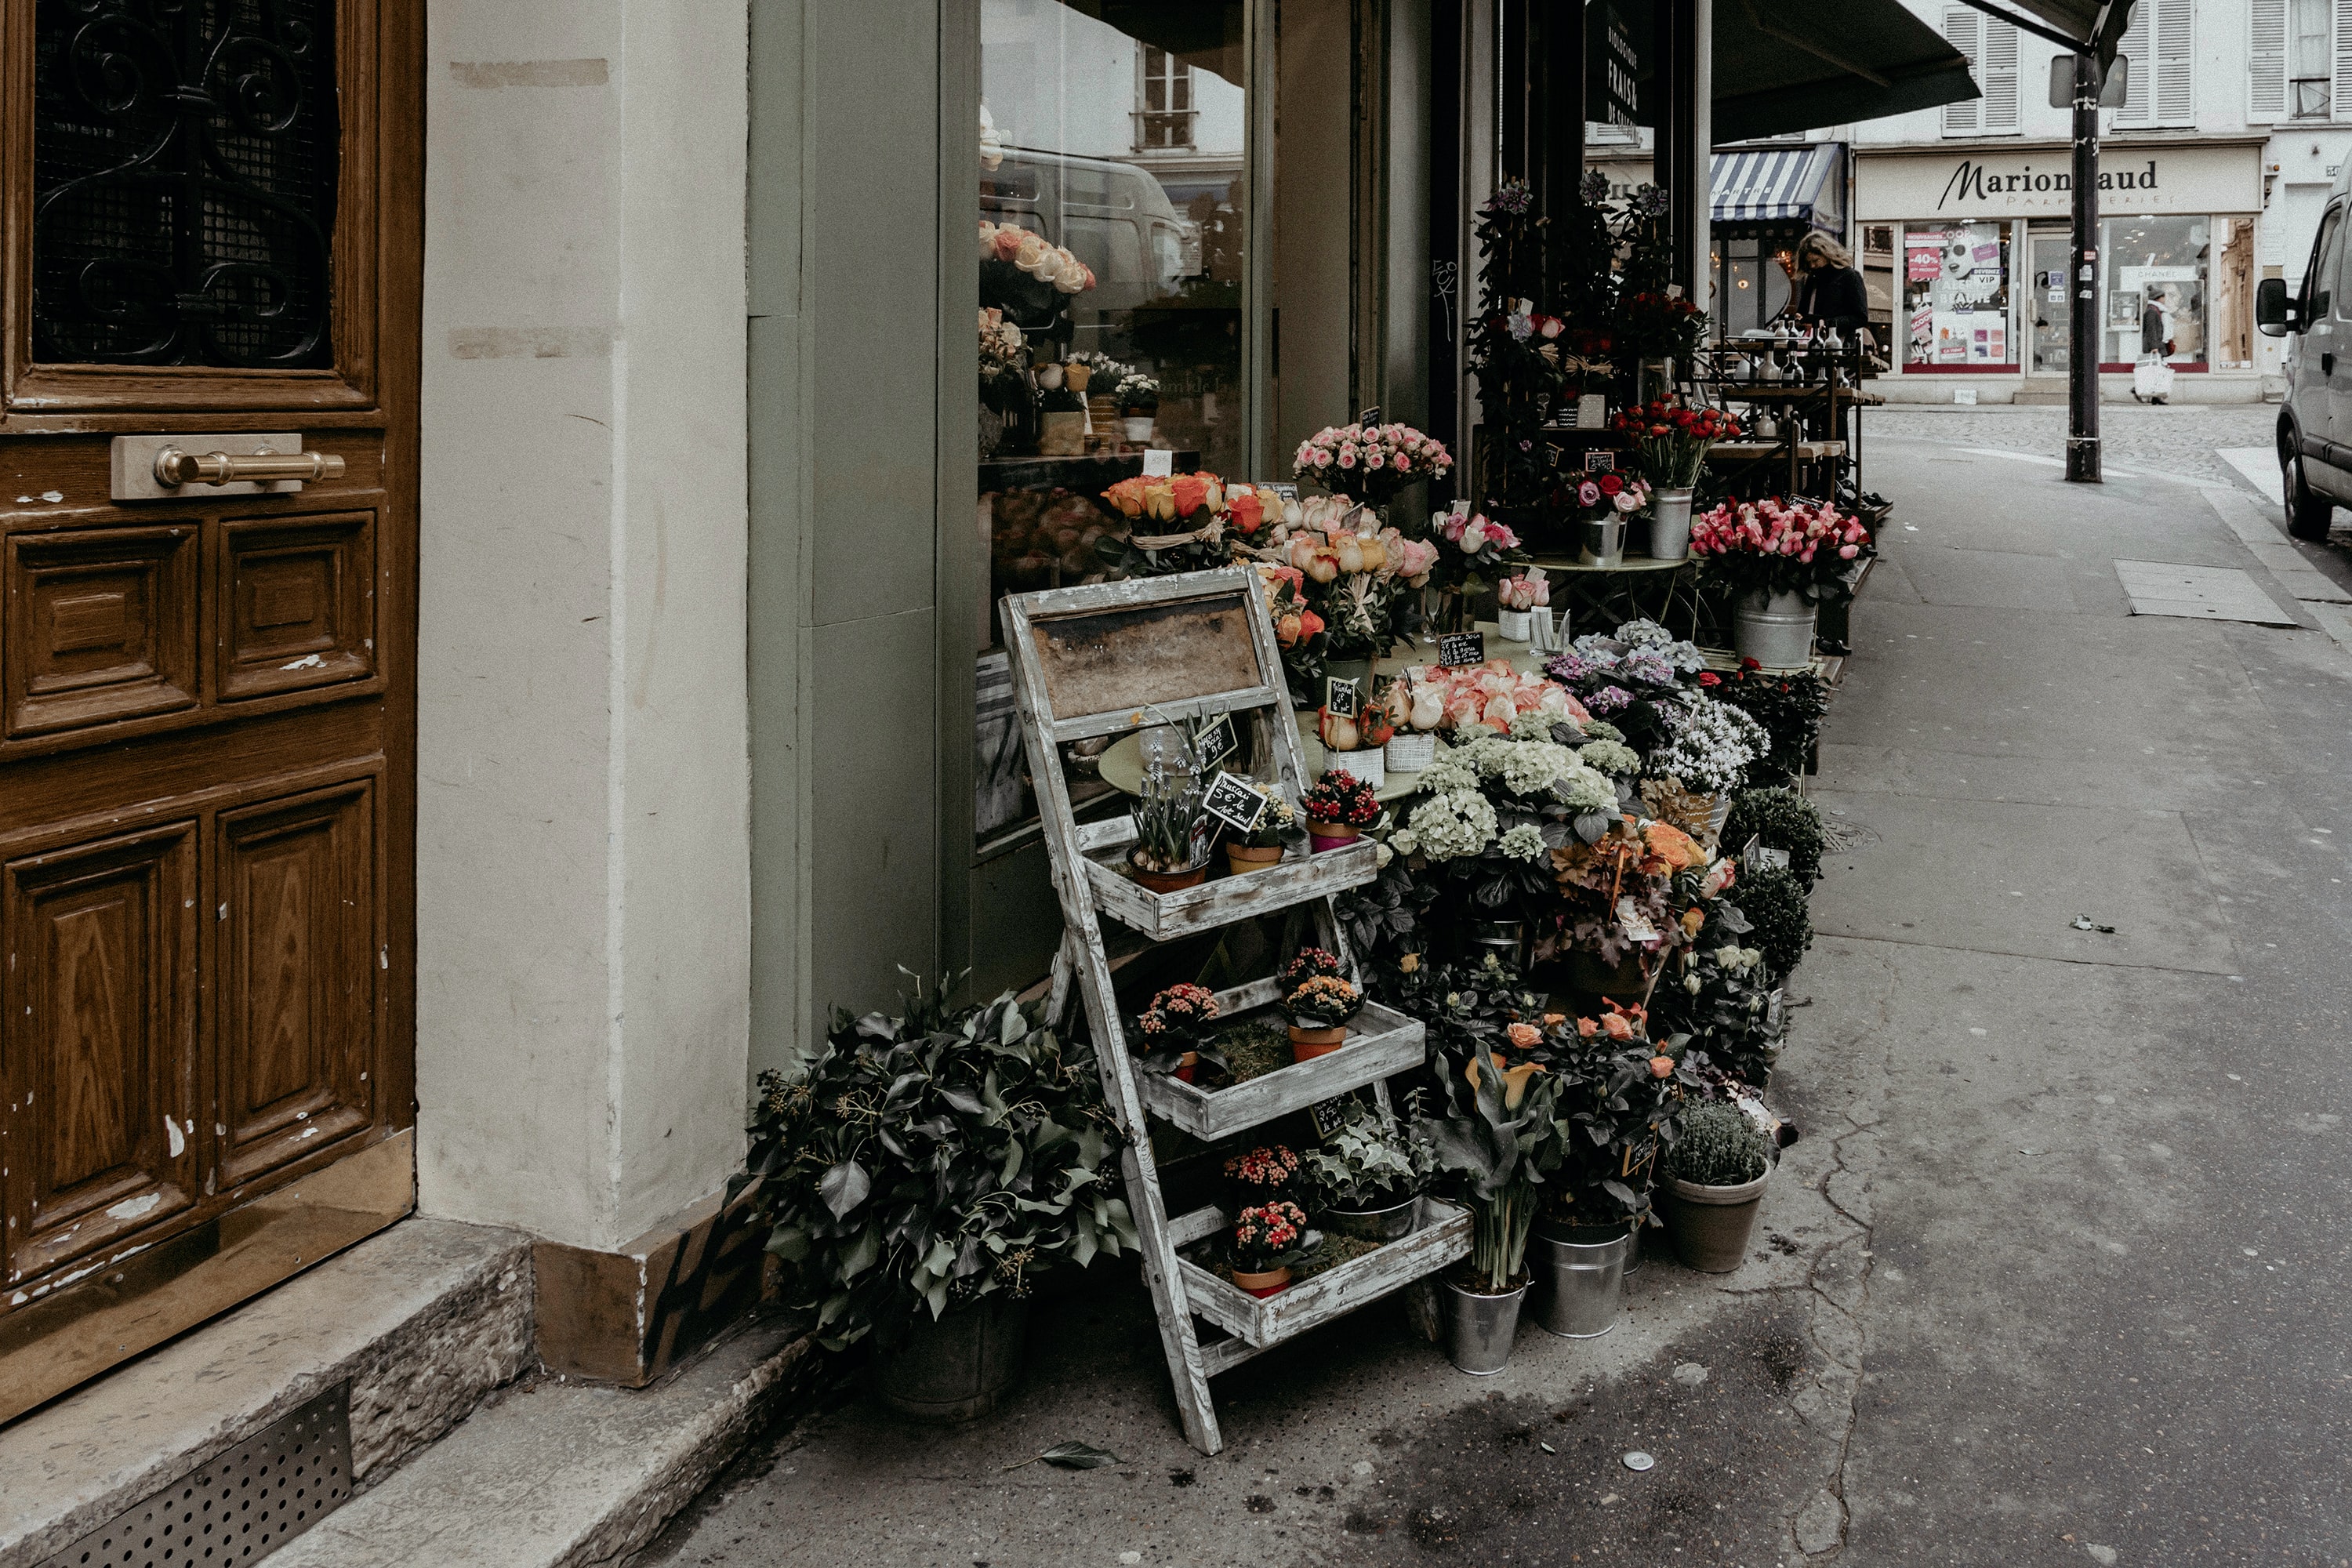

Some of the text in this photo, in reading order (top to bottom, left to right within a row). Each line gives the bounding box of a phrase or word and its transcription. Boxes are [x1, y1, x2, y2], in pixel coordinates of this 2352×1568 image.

[1608, 58, 1637, 112] FRAIS &
[1608, 100, 1616, 125] DE
[1937, 160, 2158, 210] Marionaud
[2005, 194, 2176, 206] PARFERIES
[1910, 253, 1939, 264] -40%
